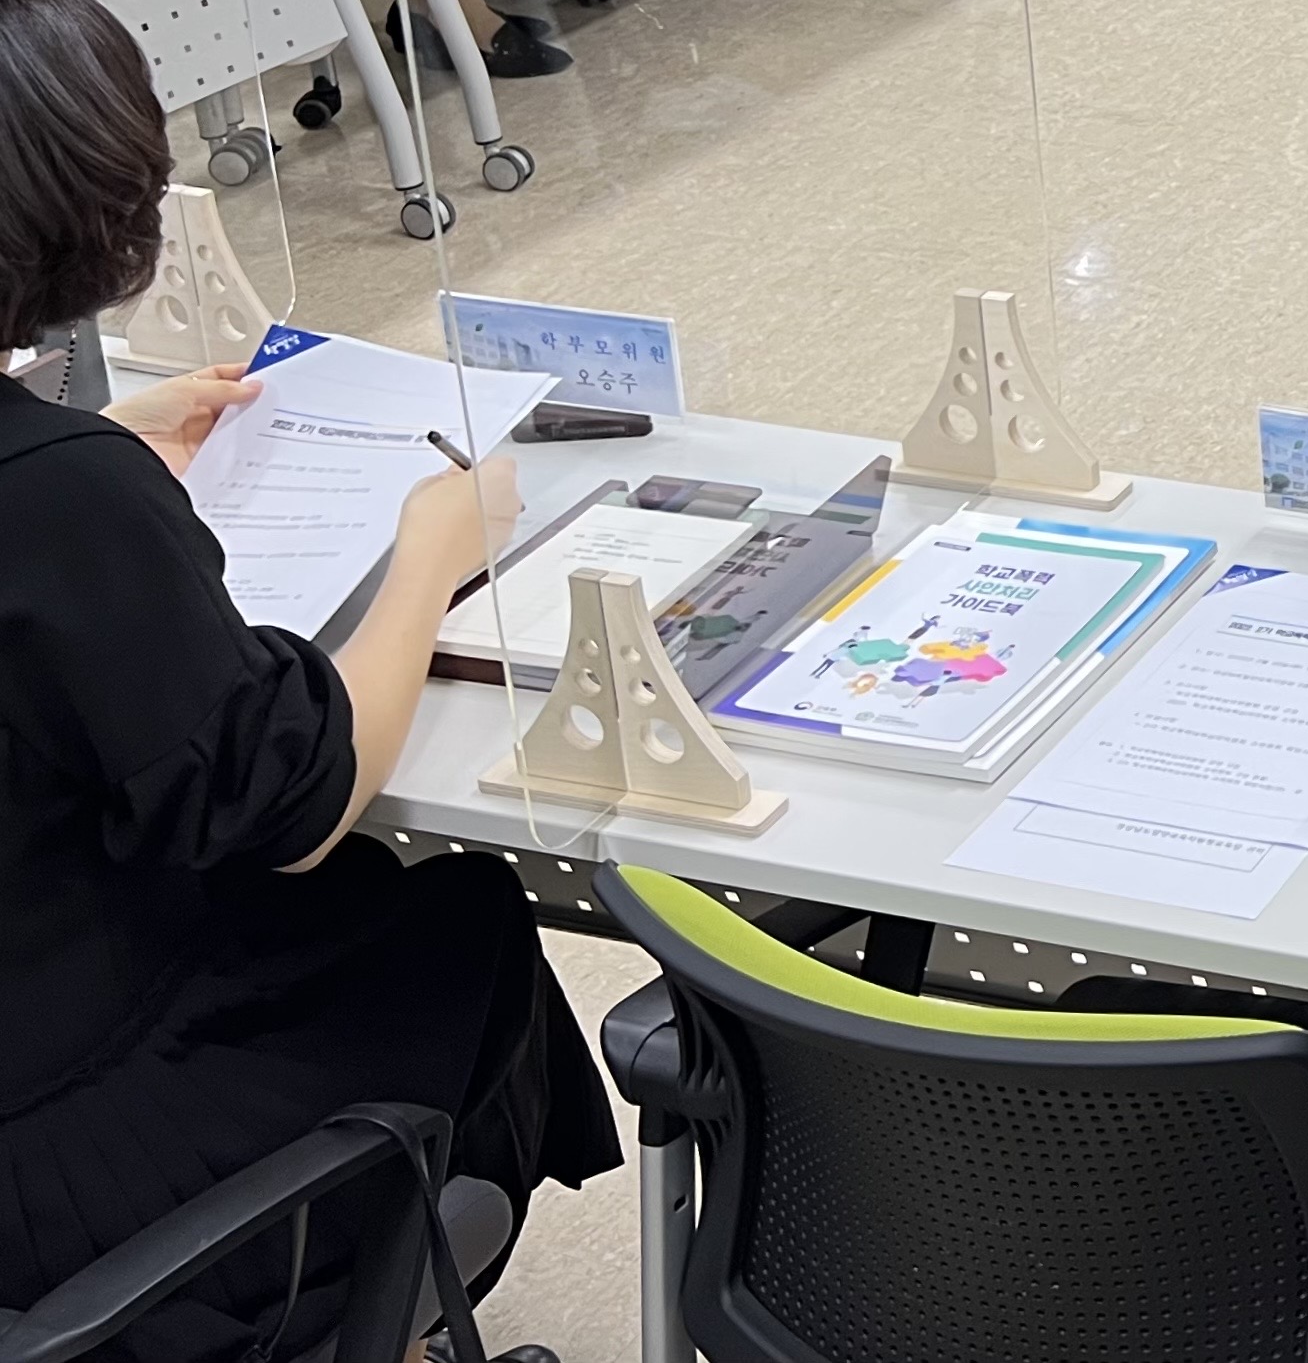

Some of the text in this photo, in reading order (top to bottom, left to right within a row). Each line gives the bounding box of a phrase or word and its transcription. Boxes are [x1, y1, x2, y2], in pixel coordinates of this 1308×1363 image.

[576, 369, 639, 395] 오승주
[974, 564, 1056, 585] 학교폭력
[956, 579, 1041, 602] 사안처리
[940, 593, 1025, 616] 가이드북
